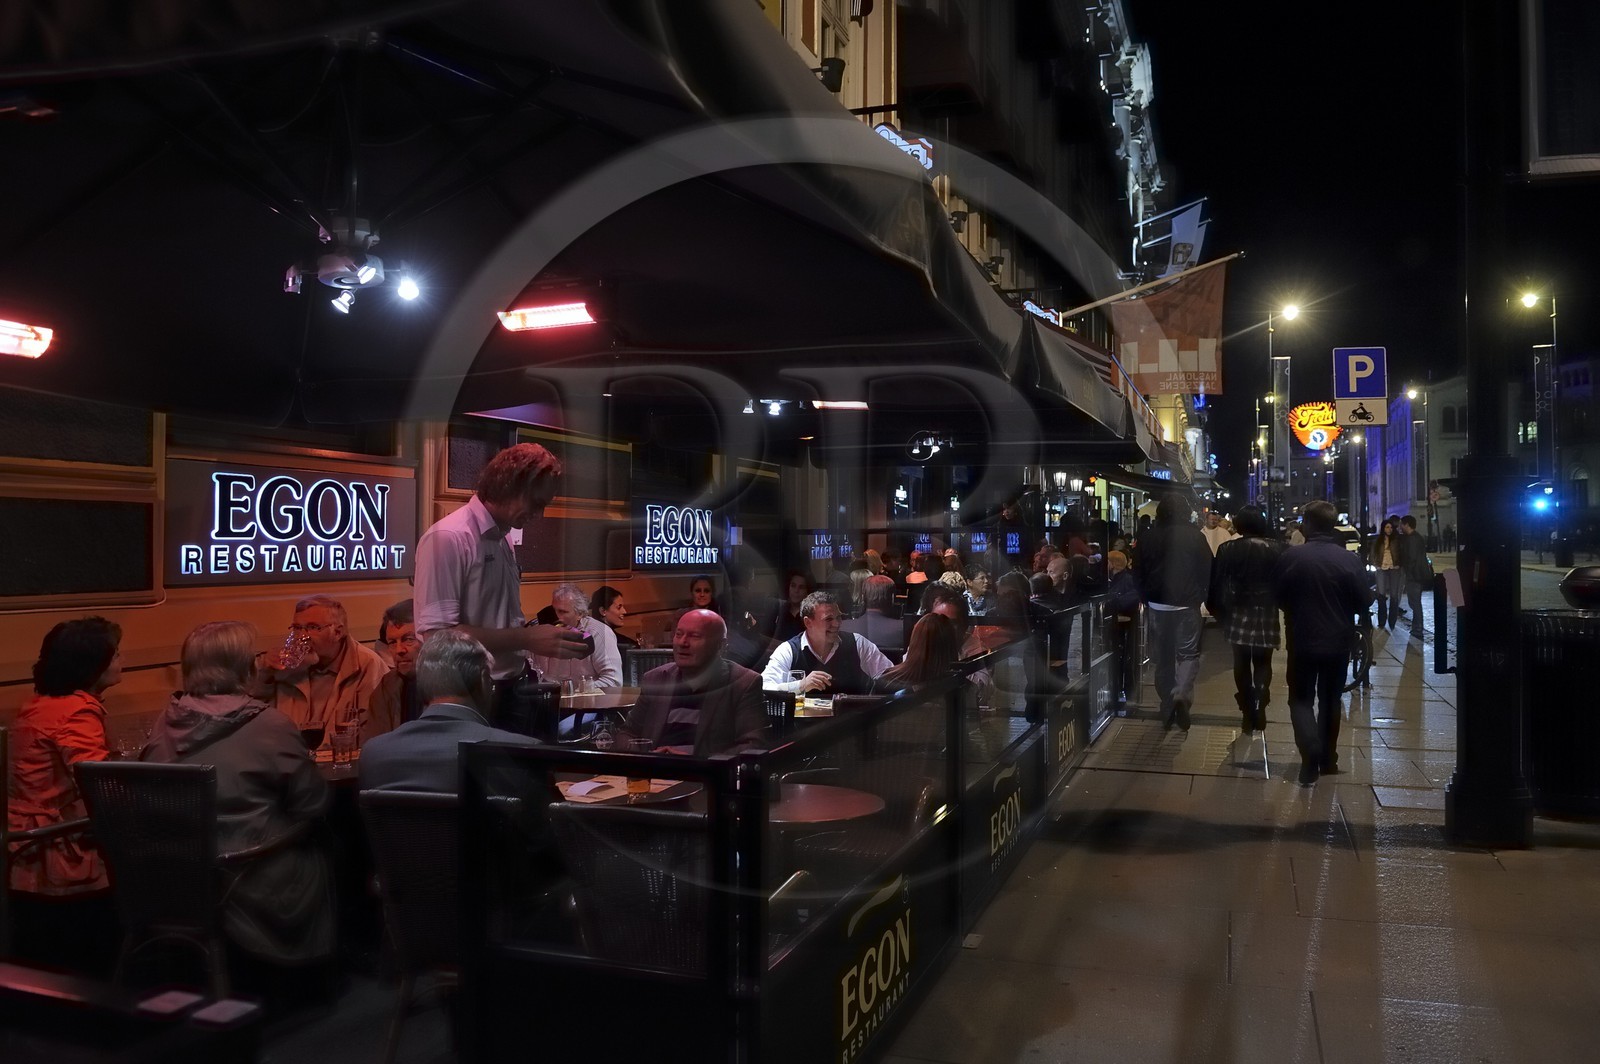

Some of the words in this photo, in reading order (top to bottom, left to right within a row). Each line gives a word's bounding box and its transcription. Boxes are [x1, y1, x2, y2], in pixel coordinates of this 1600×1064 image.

[1348, 354, 1375, 393] P
[211, 472, 390, 542] EGON
[645, 504, 712, 546] EGON
[181, 544, 406, 575] RESTAURANT
[635, 546, 719, 564] RESTAURANT
[1058, 718, 1076, 761] EGON
[991, 787, 1021, 856] EGON
[841, 908, 911, 1042] EGON
[842, 972, 910, 1064] RESTAURANT
